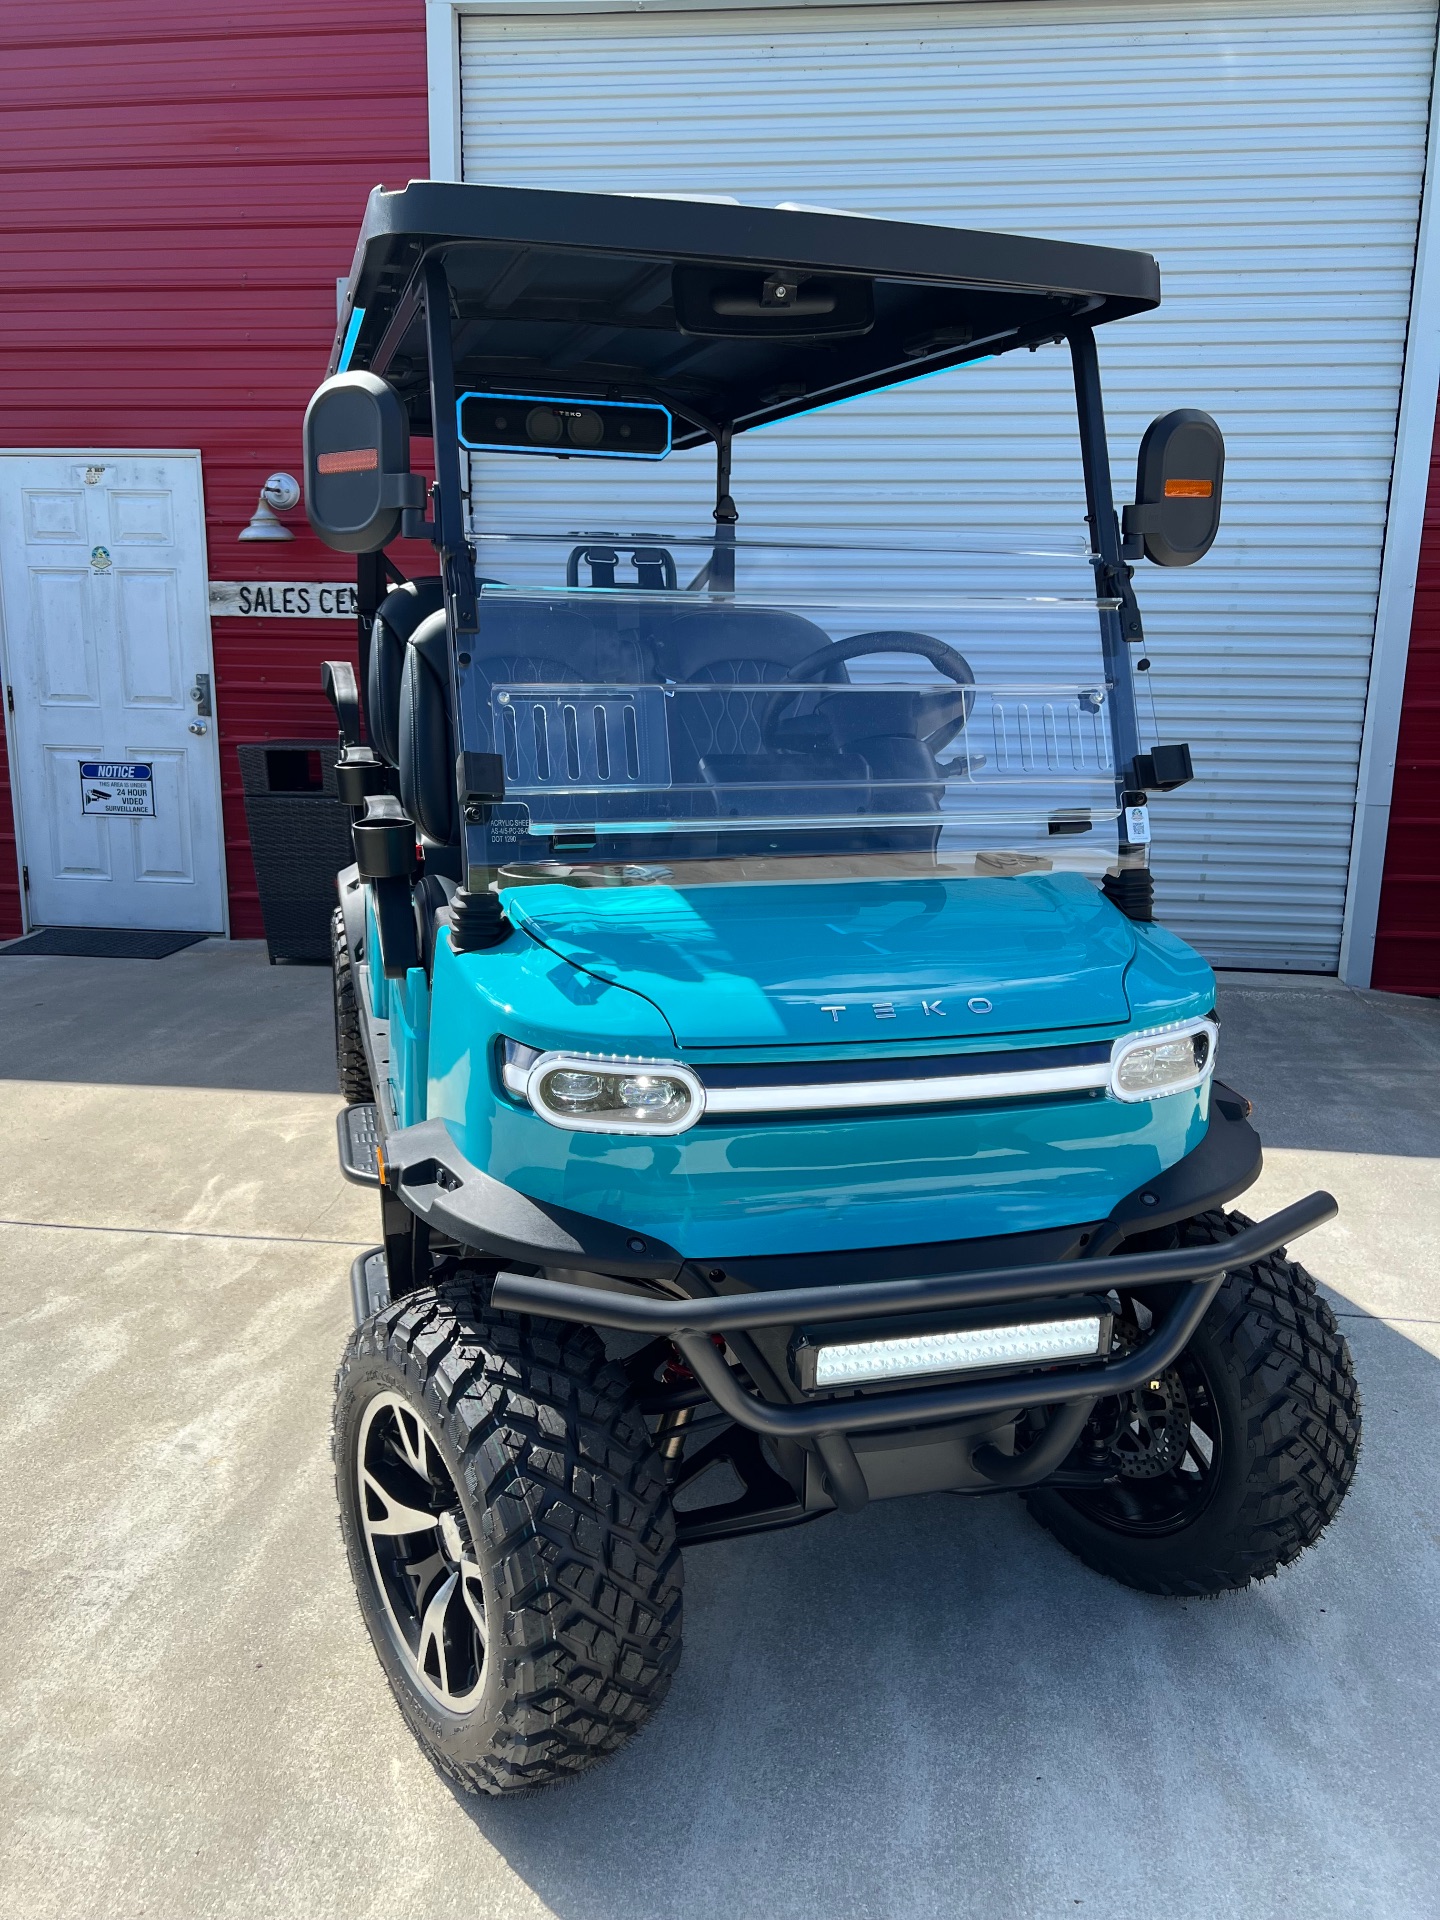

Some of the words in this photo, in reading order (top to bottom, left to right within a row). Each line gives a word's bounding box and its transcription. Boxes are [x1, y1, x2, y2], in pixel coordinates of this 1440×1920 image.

[239, 586, 311, 614] SALES
[97, 765, 135, 778] NOTICE
[116, 788, 126, 796] 24
[121, 797, 144, 805] VIDEO
[105, 805, 149, 813] SURVEILLANCE
[820, 997, 993, 1022] TEKO
